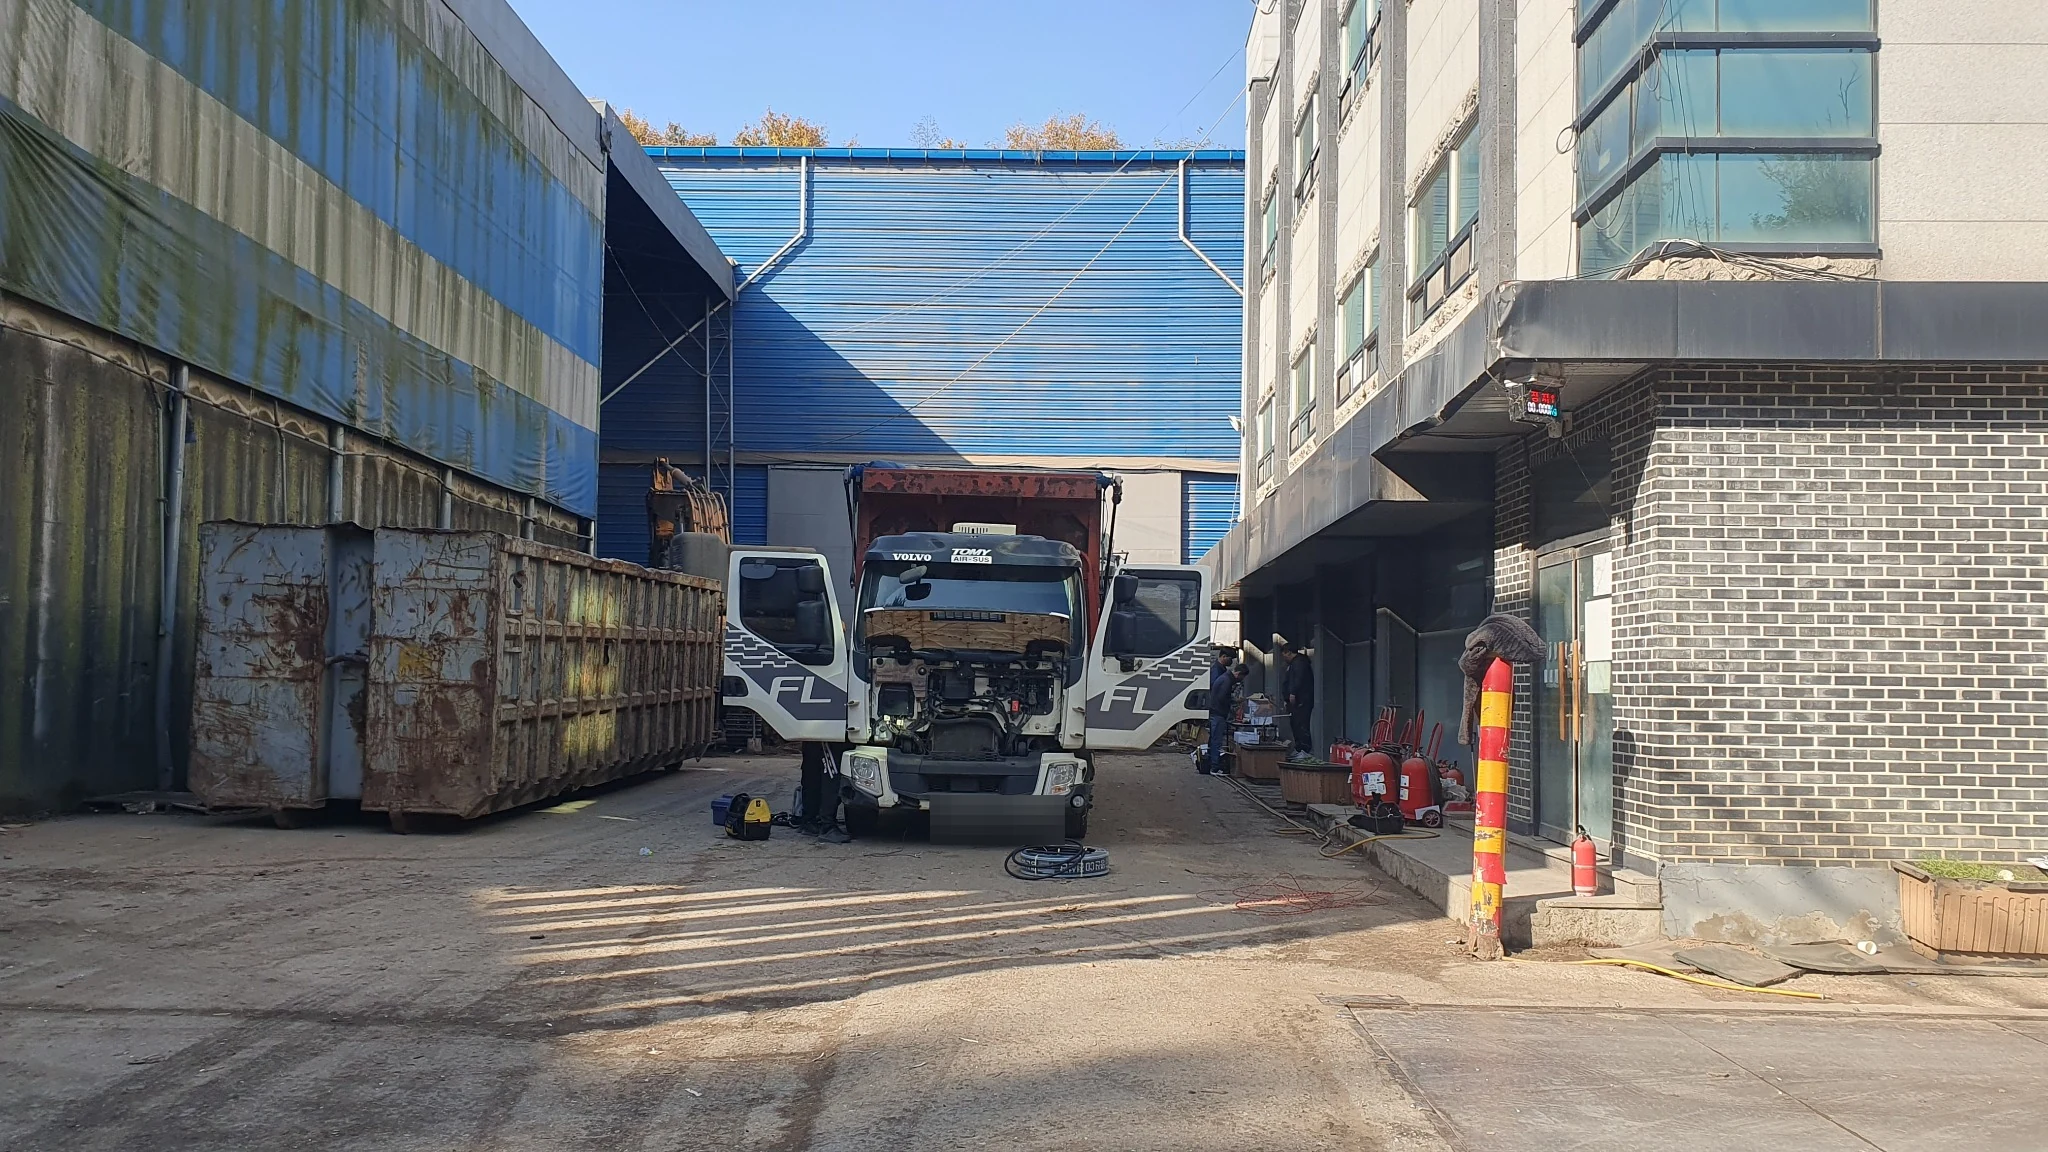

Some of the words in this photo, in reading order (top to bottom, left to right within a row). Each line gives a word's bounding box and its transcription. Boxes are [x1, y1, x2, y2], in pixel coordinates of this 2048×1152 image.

[892, 553, 932, 562] VOLVO
[951, 548, 992, 556] TOMY
[769, 676, 831, 703] FL
[1100, 685, 1160, 714] FL
